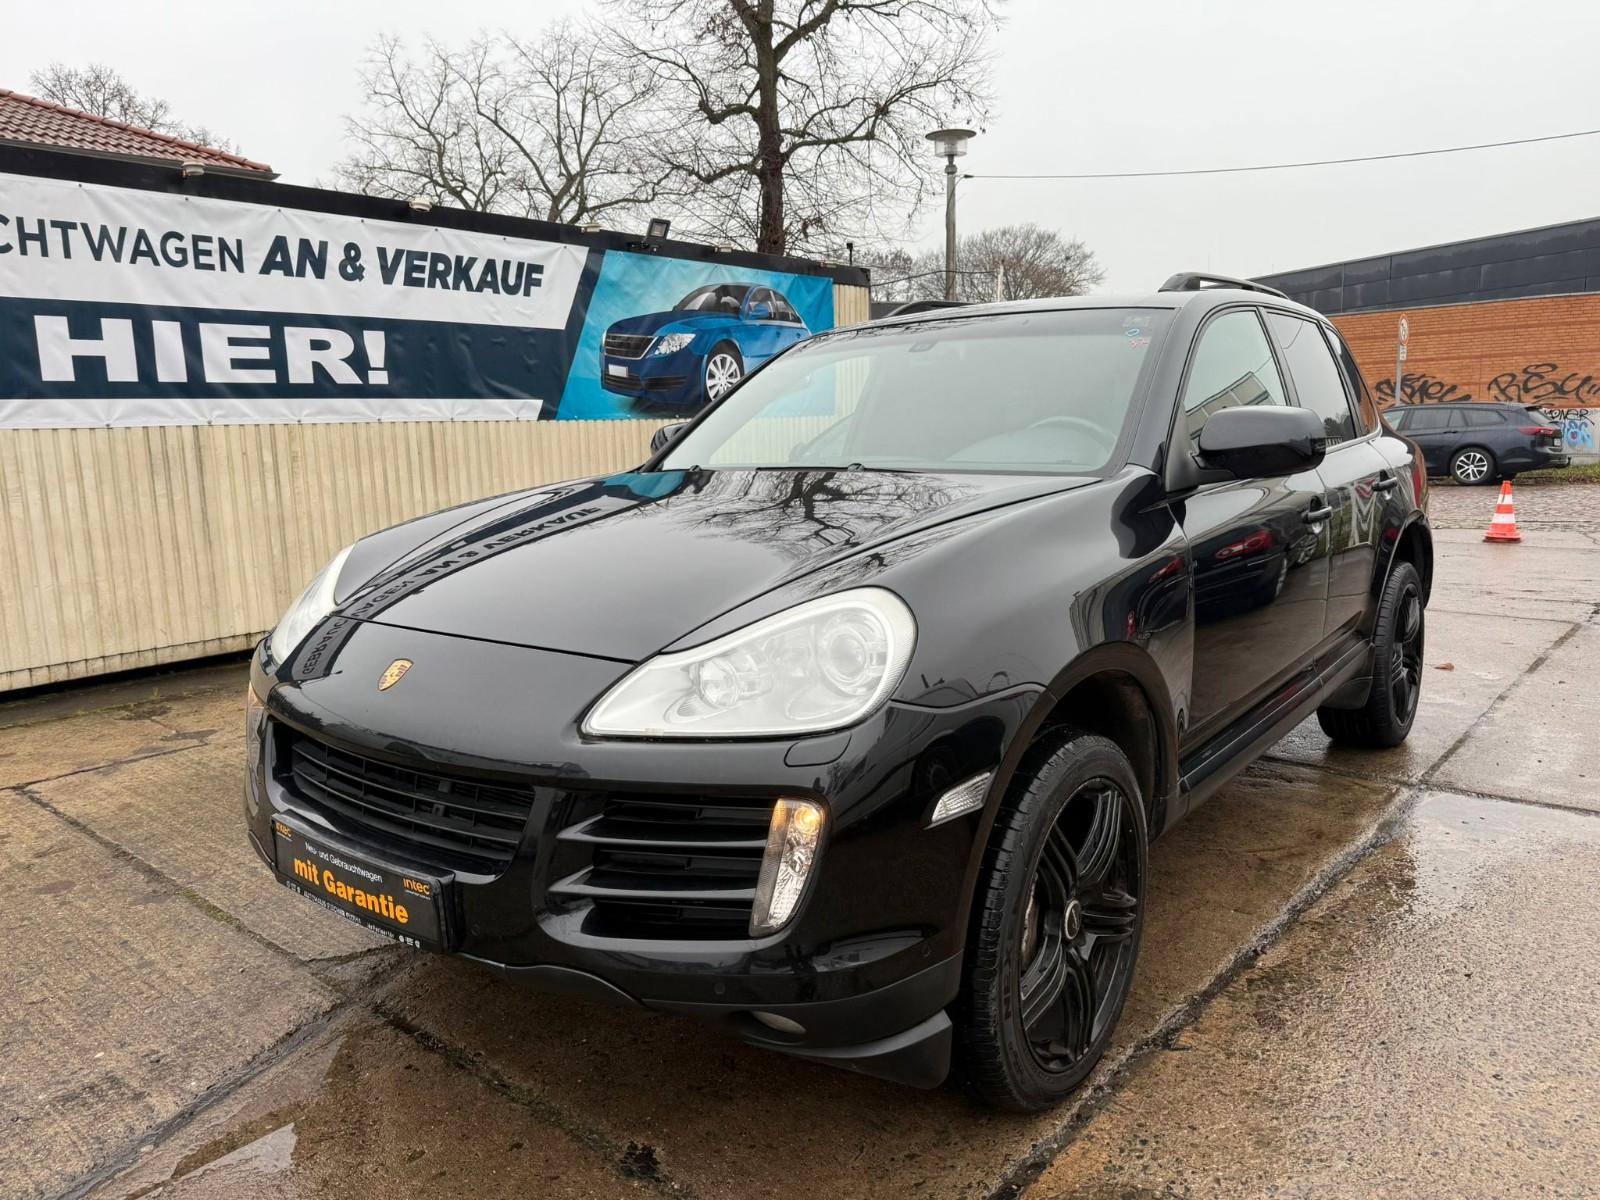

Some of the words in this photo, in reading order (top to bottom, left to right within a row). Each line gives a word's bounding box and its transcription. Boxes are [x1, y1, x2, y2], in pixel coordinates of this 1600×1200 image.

[259, 235, 327, 280] AN
[338, 241, 365, 282] &
[376, 246, 545, 297] VERKAUF
[33, 314, 389, 385] HIER!
[293, 857, 320, 887] mit
[322, 869, 409, 924] Garantie
[329, 854, 383, 884] Gebrauchtwagen
[402, 877, 431, 895] intec
